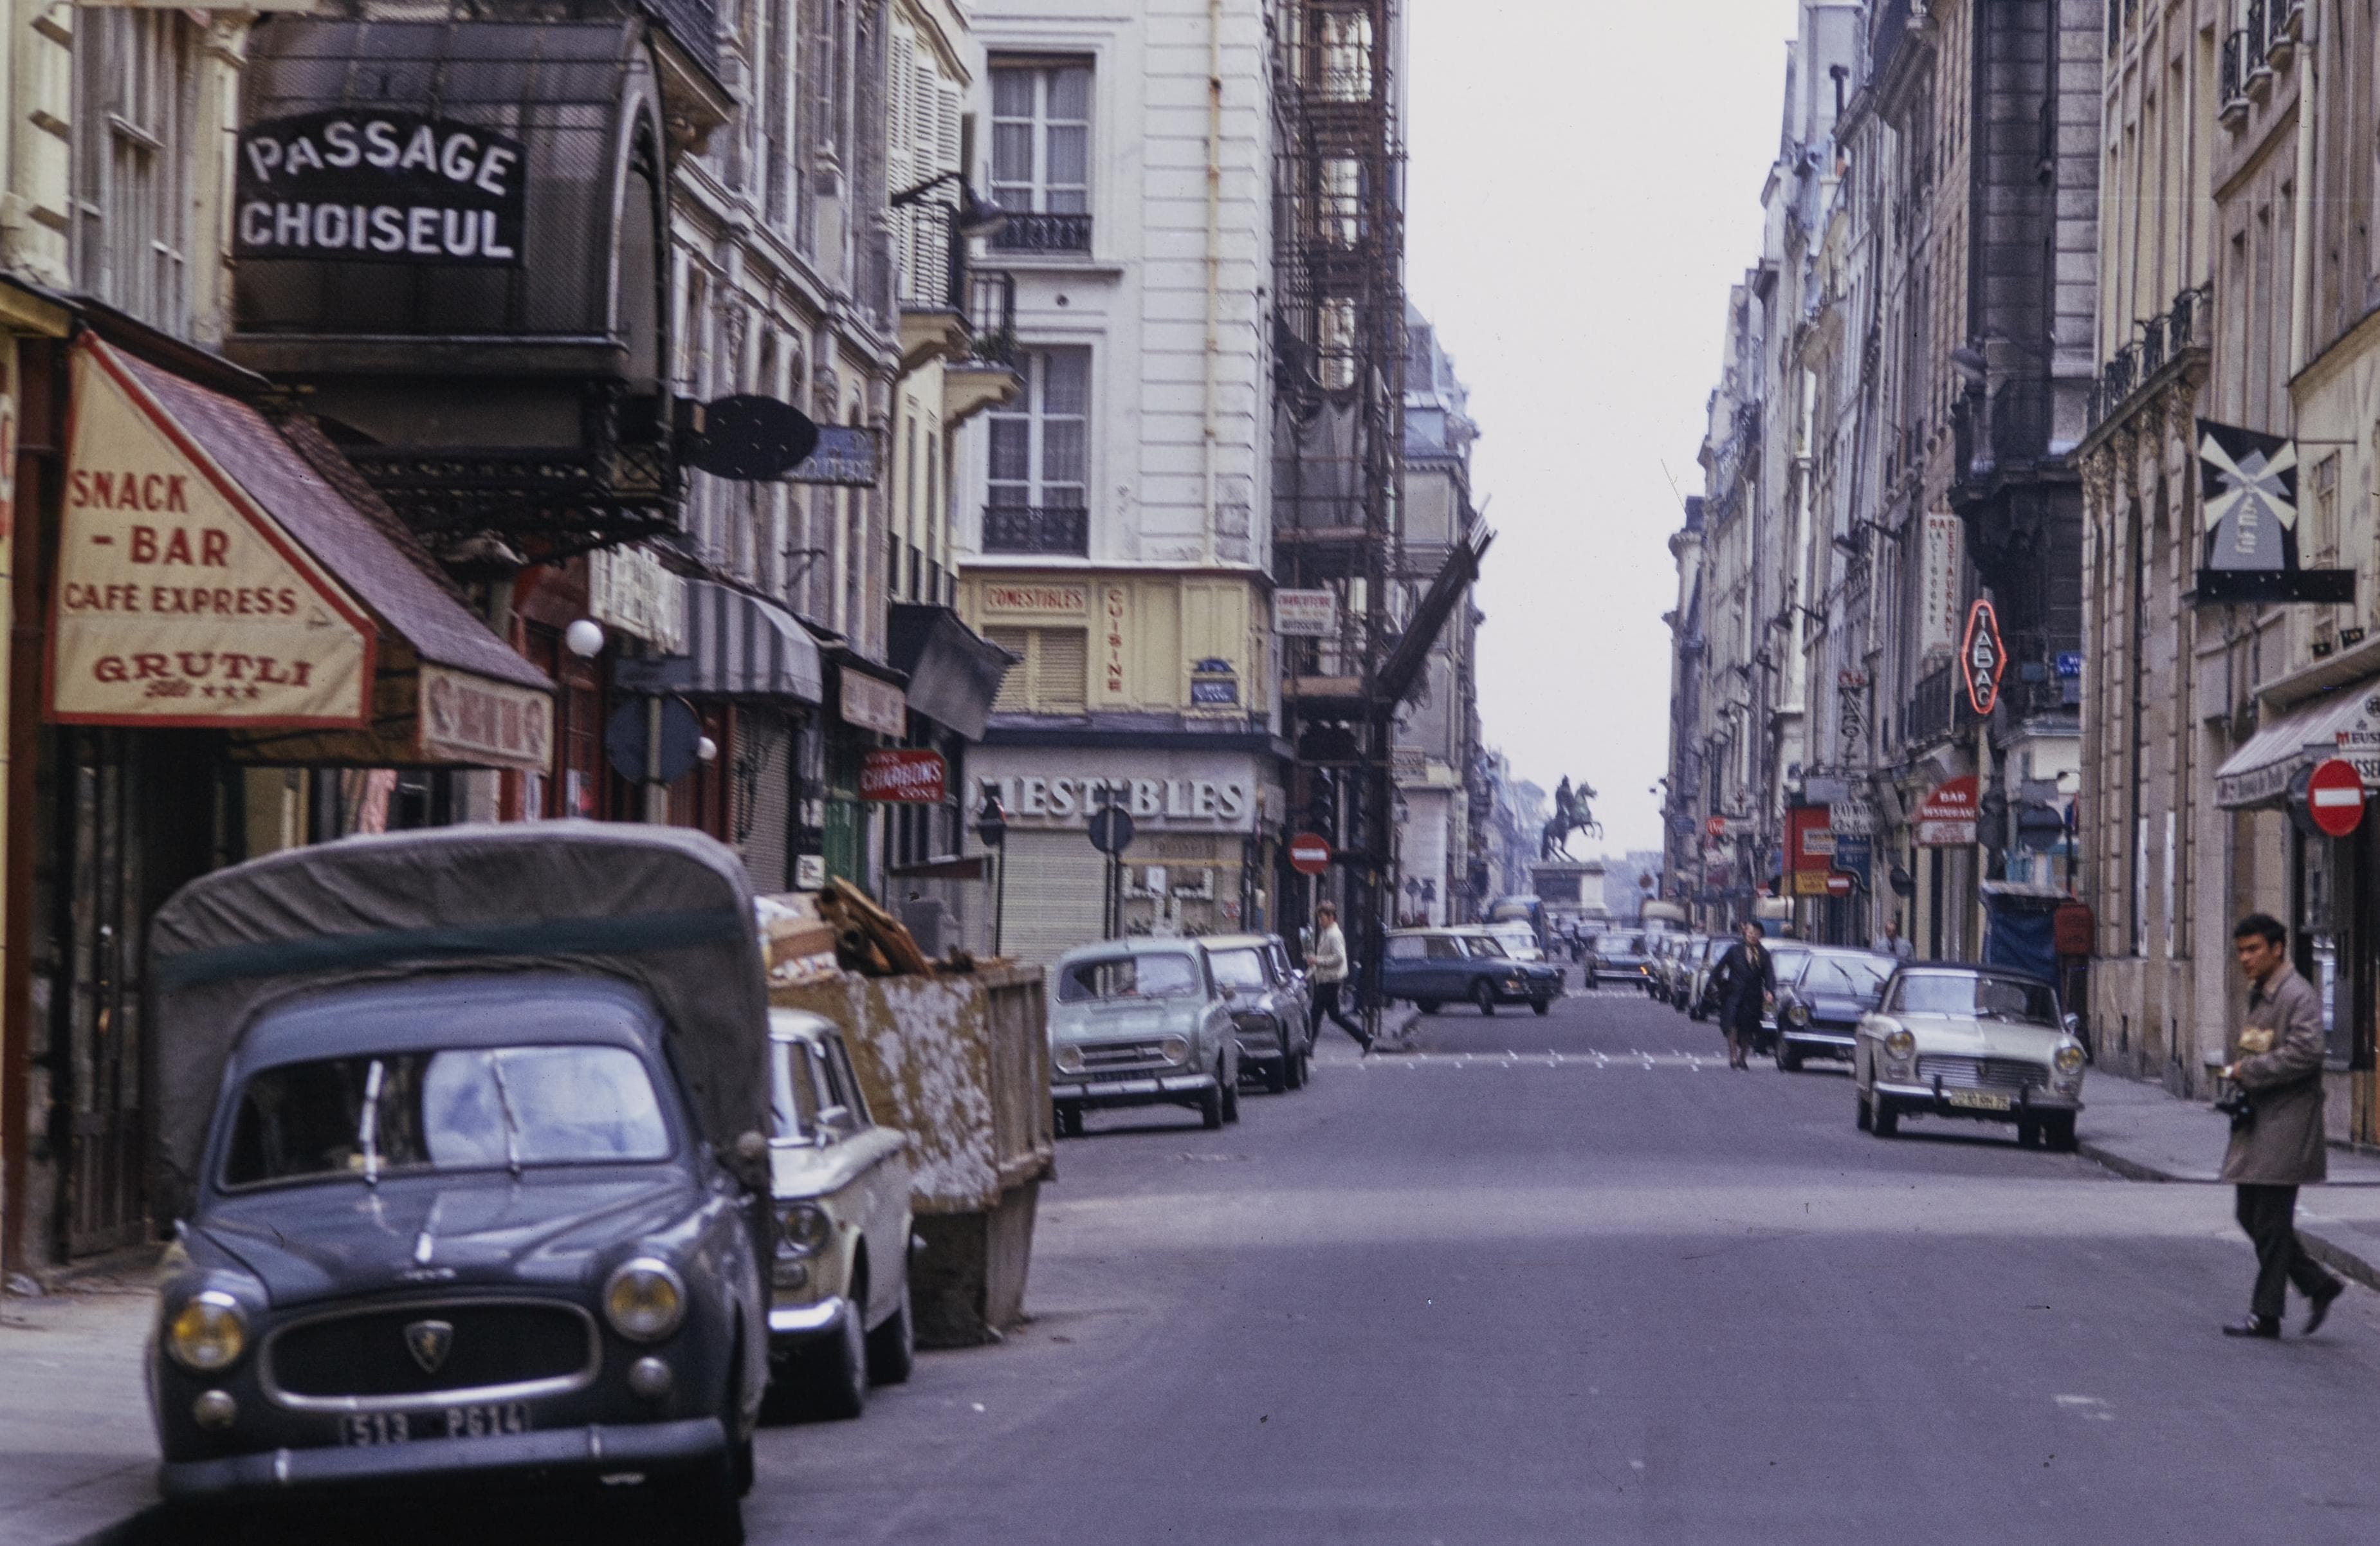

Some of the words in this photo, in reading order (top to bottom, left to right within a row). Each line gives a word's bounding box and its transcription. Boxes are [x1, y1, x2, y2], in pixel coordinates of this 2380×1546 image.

[246, 120, 517, 196] PASSAGE
[239, 200, 514, 257] CHOISEUL
[69, 468, 188, 513] SNACK
[130, 524, 230, 567] BAR
[150, 584, 298, 615] EXPRESS
[988, 587, 1083, 609] COMESTIBLES
[1106, 588, 1123, 693] CUISINE
[1973, 609, 1993, 706] TABAC
[93, 650, 313, 687] GRUTLI
[2336, 732, 2380, 745] MEUS
[966, 777, 1244, 820] ESTBLES
[1939, 792, 1966, 803] BAR
